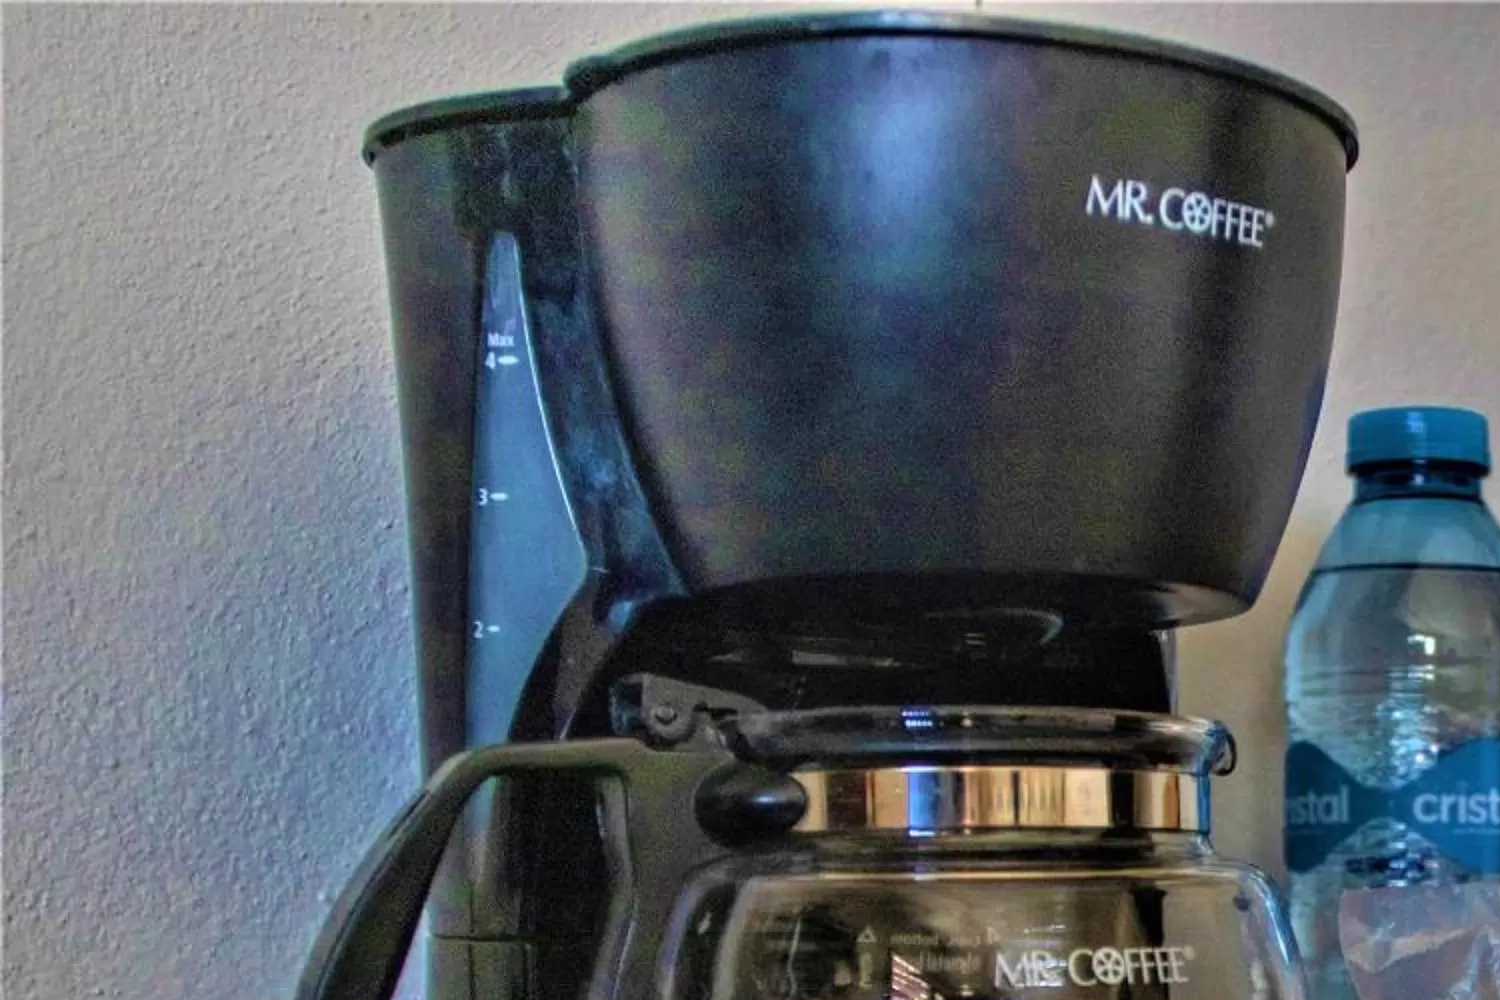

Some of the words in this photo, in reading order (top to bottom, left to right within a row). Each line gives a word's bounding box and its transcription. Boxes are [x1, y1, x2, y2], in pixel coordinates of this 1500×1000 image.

[1085, 173, 1154, 225] MR.
[487, 332, 514, 347] Max
[485, 351, 496, 369] 4
[478, 488, 488, 506] 3
[473, 621, 483, 639] 2
